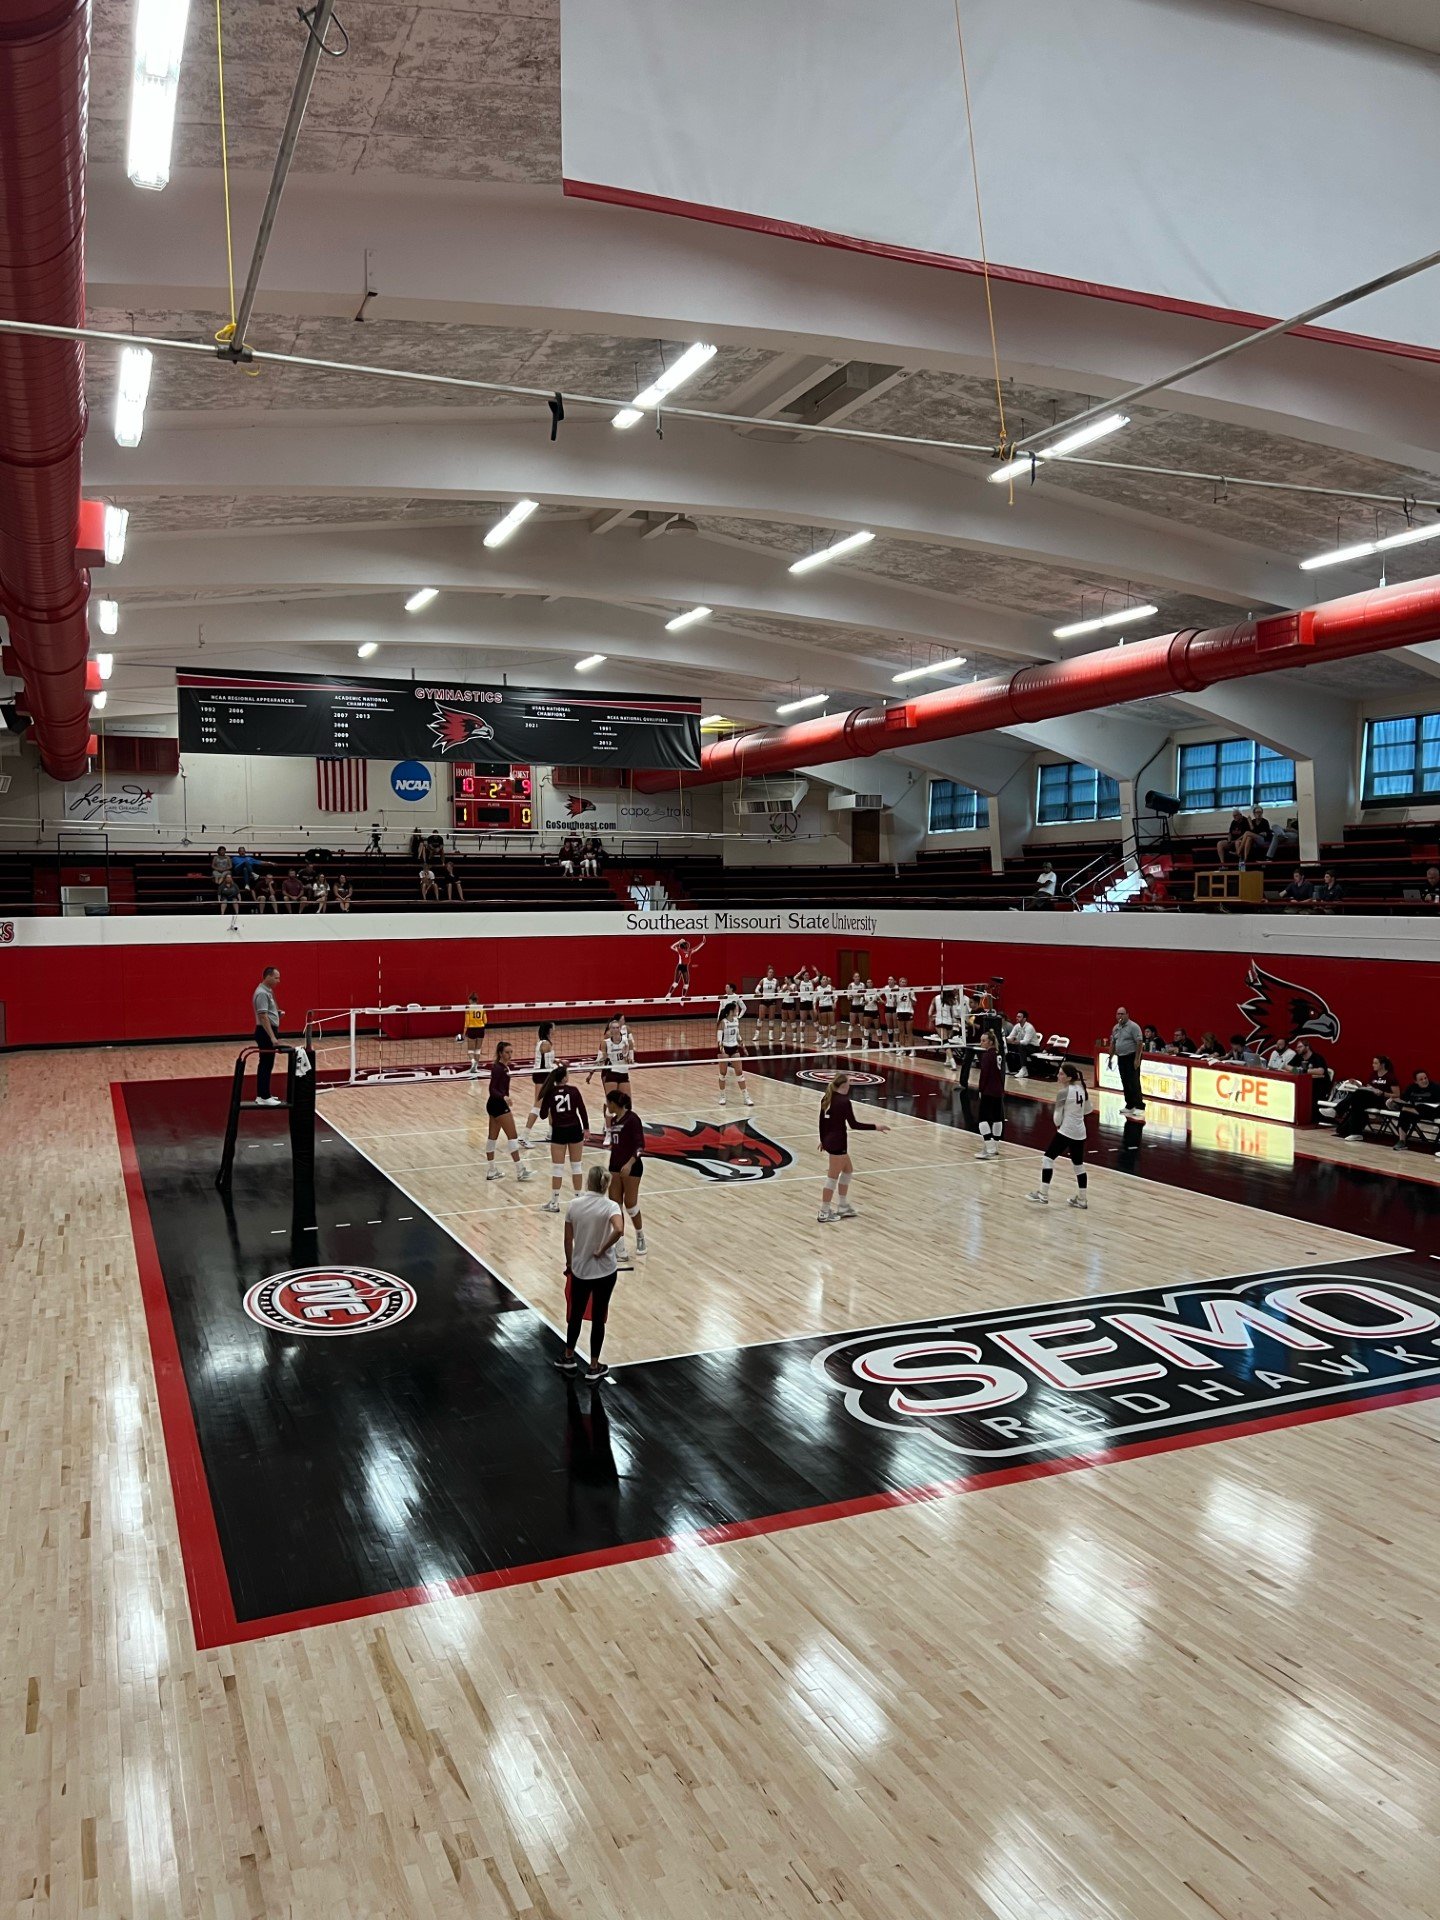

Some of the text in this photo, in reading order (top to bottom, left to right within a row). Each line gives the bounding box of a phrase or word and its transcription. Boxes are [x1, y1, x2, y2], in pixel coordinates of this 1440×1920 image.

[414, 687, 503, 703] GYMNASTICS
[456, 767, 474, 777] HOME
[512, 770, 529, 779] GUEST
[395, 780, 430, 791] NCAA
[463, 777, 474, 792] 10
[489, 783, 498, 799] 2
[521, 779, 531, 794] 9
[69, 783, 150, 820] Legends
[463, 807, 468, 822] 1
[521, 807, 531, 824] 0
[620, 805, 691, 818] cape trals
[545, 820, 617, 830] GoSoutheast.com
[626, 912, 877, 935] Southeast Missouri State University
[472, 1010, 482, 1019] 10
[554, 1093, 572, 1113] 21
[1075, 1090, 1084, 1108] 4
[852, 1284, 1440, 1415] SEMO
[981, 1338, 1440, 1439] REDHAWK
